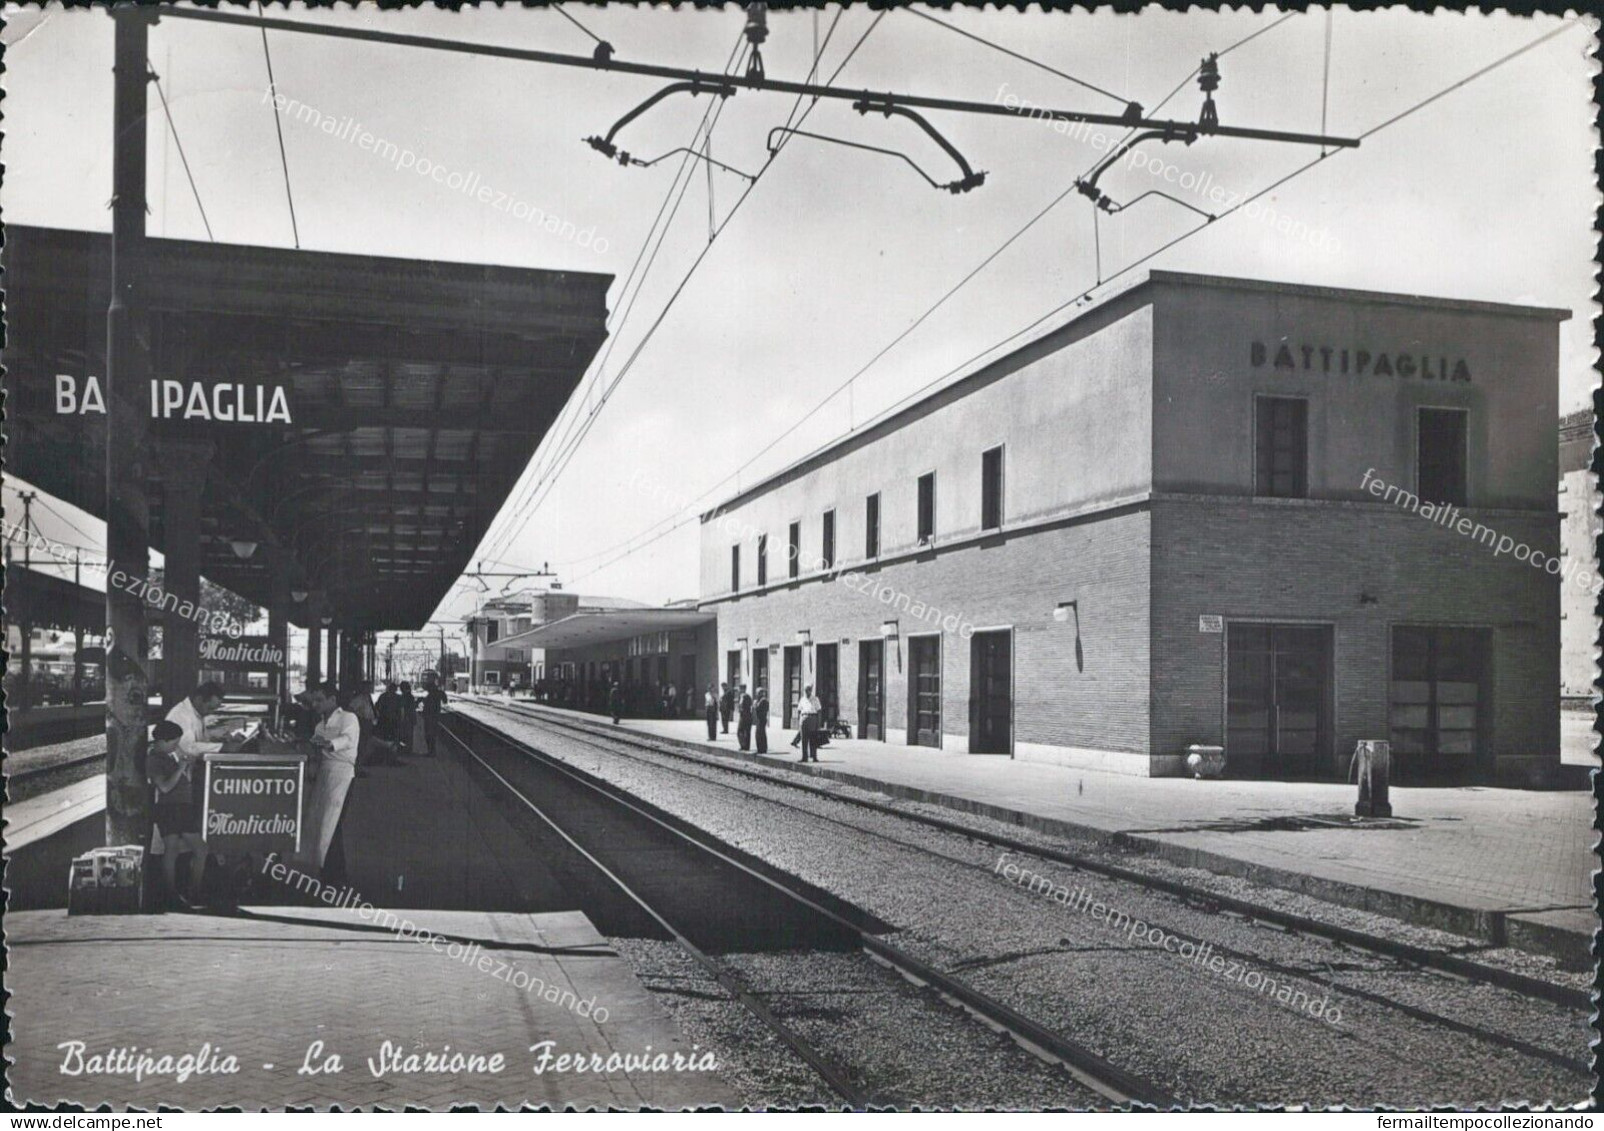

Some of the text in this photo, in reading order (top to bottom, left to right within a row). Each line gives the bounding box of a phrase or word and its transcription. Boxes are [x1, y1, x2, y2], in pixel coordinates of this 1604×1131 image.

[1250, 341, 1472, 382] BATTIPAGLIA
[55, 374, 292, 424] BAIPAGLIA
[212, 778, 296, 795] CHINOTTO
